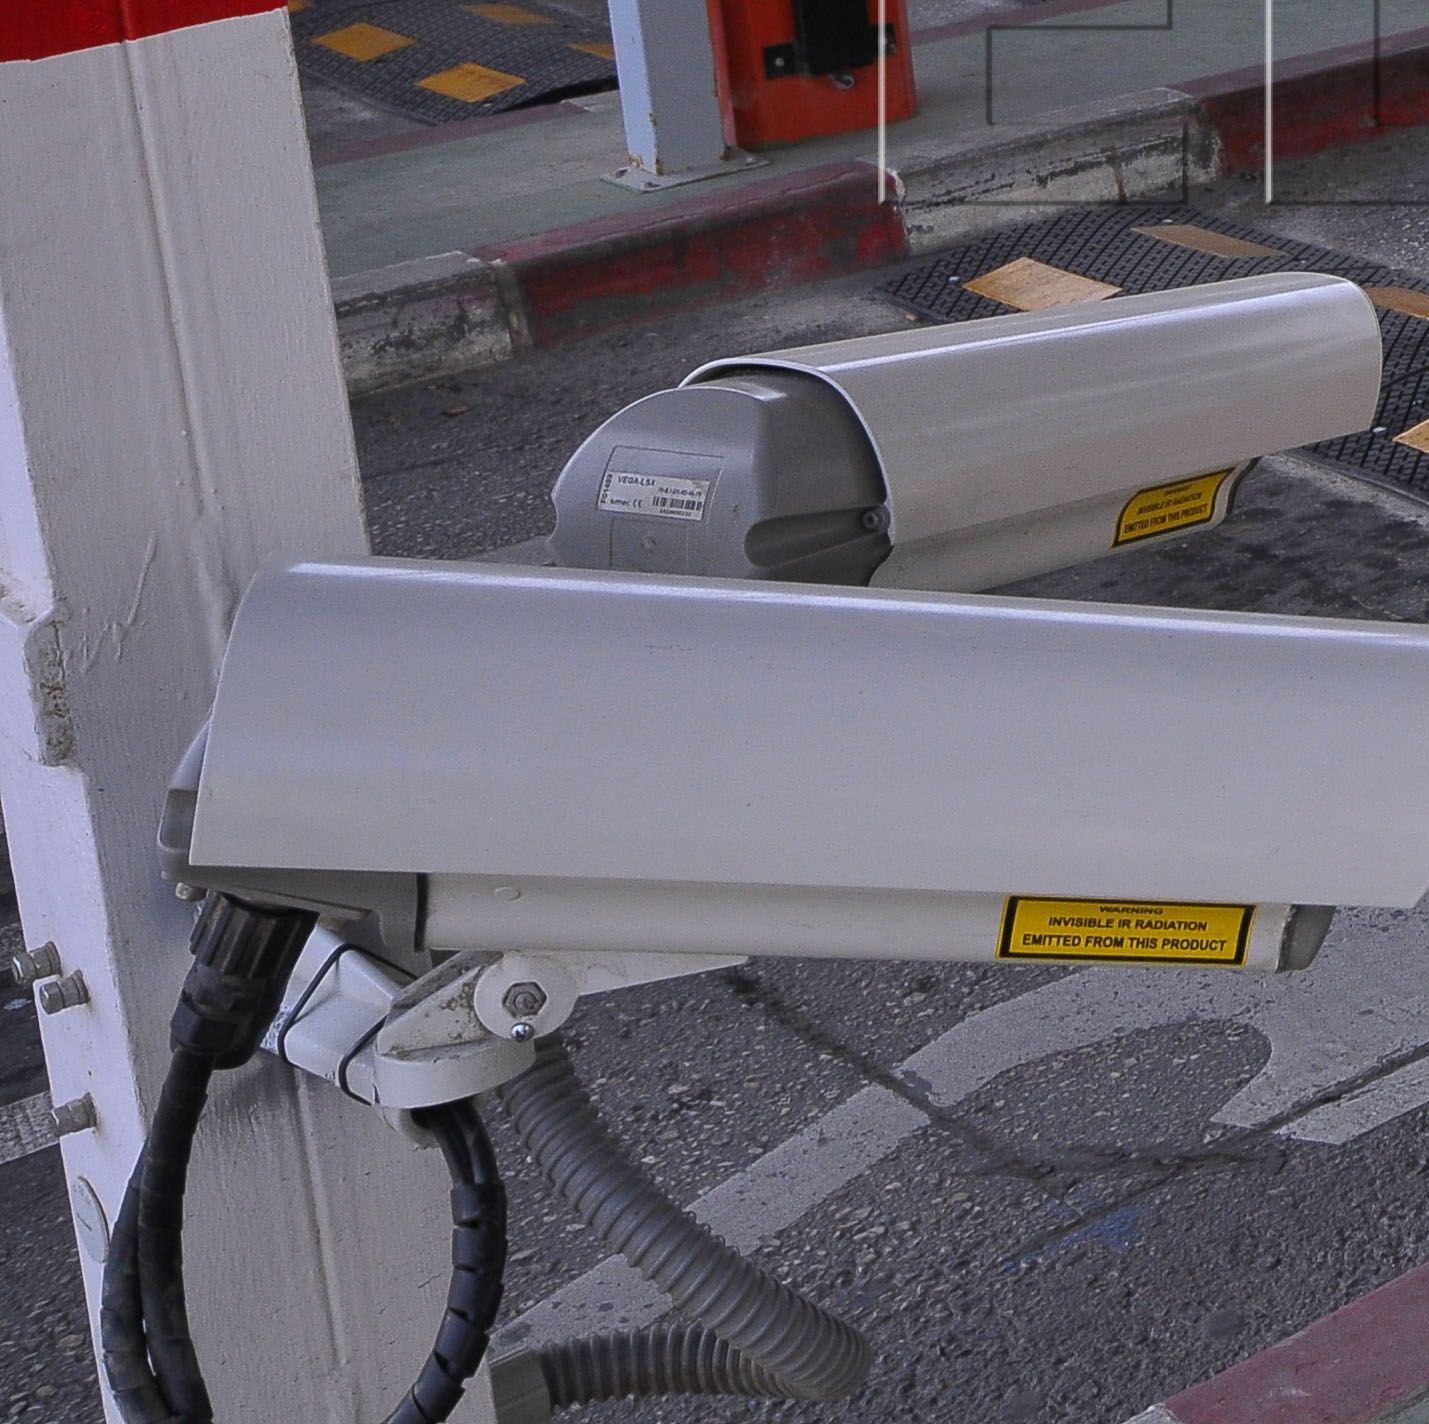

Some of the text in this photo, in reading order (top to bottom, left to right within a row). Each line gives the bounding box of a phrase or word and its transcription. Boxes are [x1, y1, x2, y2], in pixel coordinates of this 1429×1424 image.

[1100, 906, 1164, 915] WARNING
[1048, 916, 1208, 932] INVISIBLE IR RADIATION
[1022, 933, 1228, 951] EMITTED FROM THIS PRODUCT
